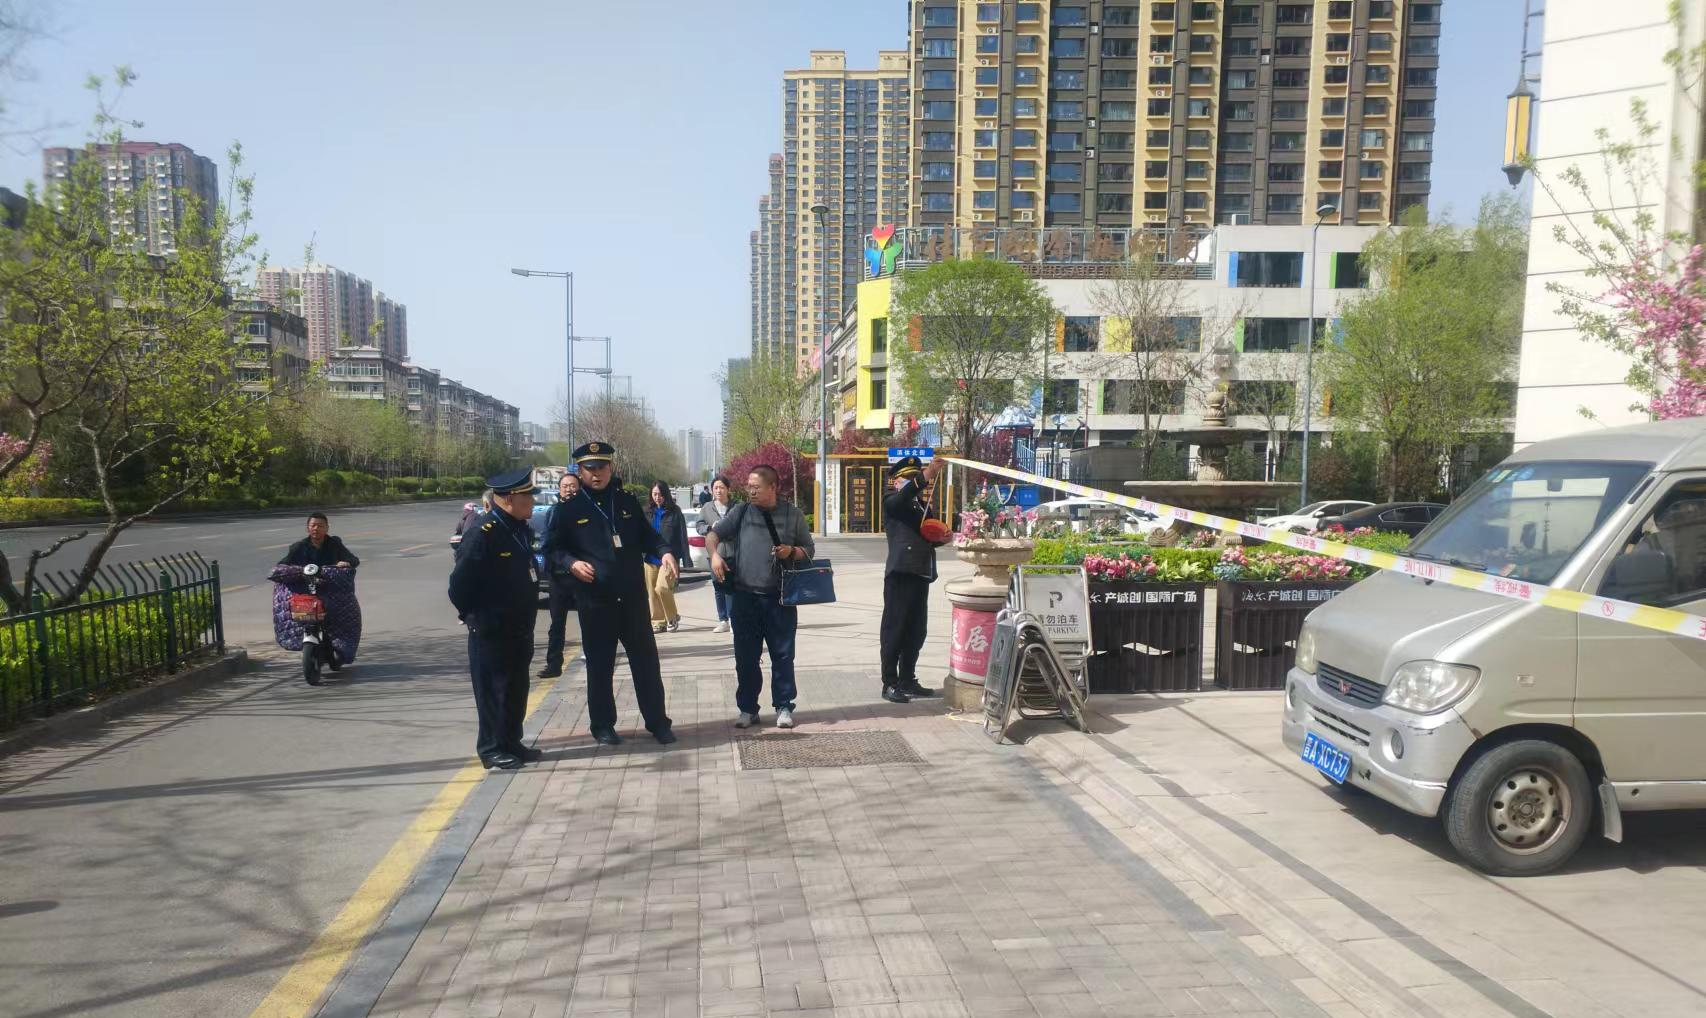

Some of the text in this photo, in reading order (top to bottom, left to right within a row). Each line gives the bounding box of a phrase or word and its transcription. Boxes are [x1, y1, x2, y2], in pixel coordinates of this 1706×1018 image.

[1494, 578, 1530, 599] 警戒线
[1145, 590, 1197, 603] 国际广场
[1047, 626, 1079, 634] PARKING
